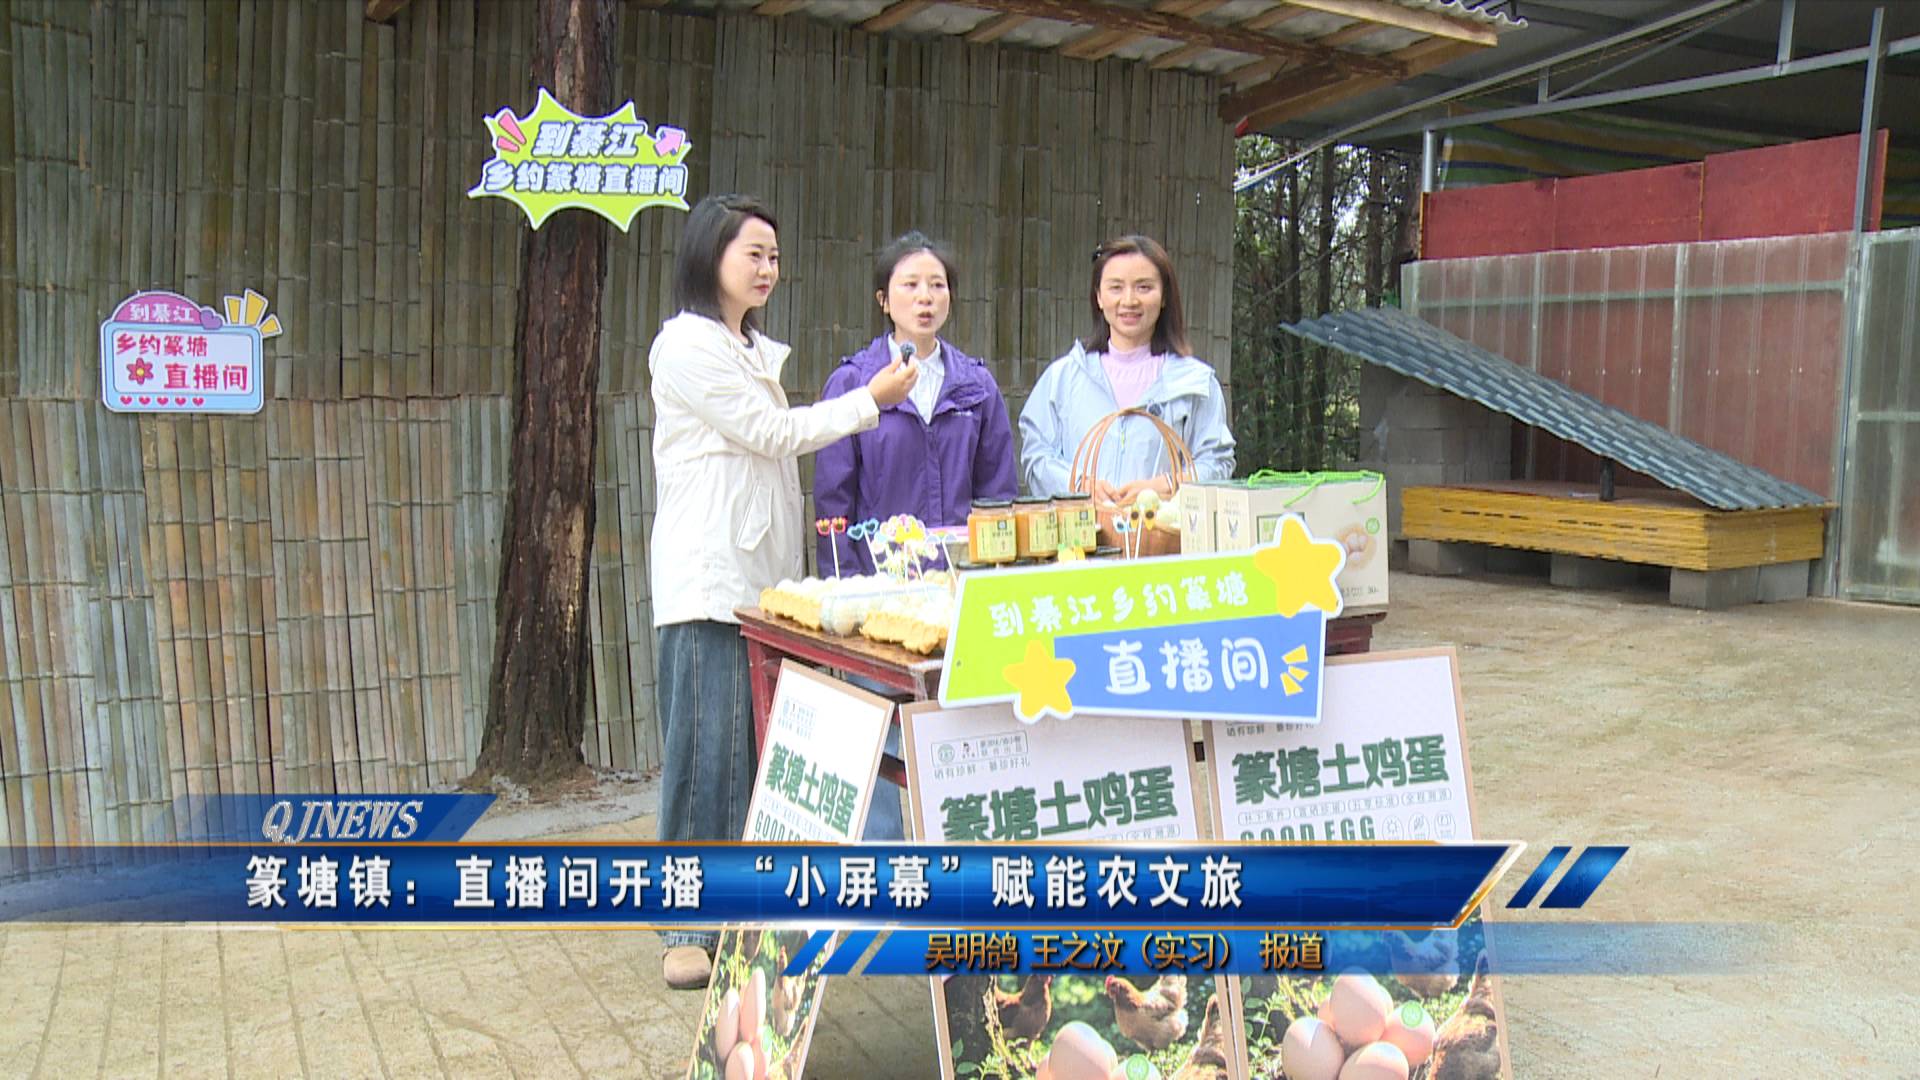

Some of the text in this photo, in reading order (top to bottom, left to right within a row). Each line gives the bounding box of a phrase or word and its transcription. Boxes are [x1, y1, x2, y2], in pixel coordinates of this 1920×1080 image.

[531, 121, 644, 157] 到綦江
[484, 161, 686, 196] 乡约篆塘直播间
[129, 303, 194, 323] 到綦江
[116, 333, 208, 357] 乡约篆塘
[163, 363, 248, 391] 直播间
[988, 571, 1249, 638] 到綦江乡约篆塘
[1103, 637, 1270, 695] 直播间
[765, 741, 859, 838] 篆塘土鸡蛋
[1232, 734, 1450, 805] 篆塘土鸡蛋
[940, 765, 1178, 841] 篆塘土鸡蛋
